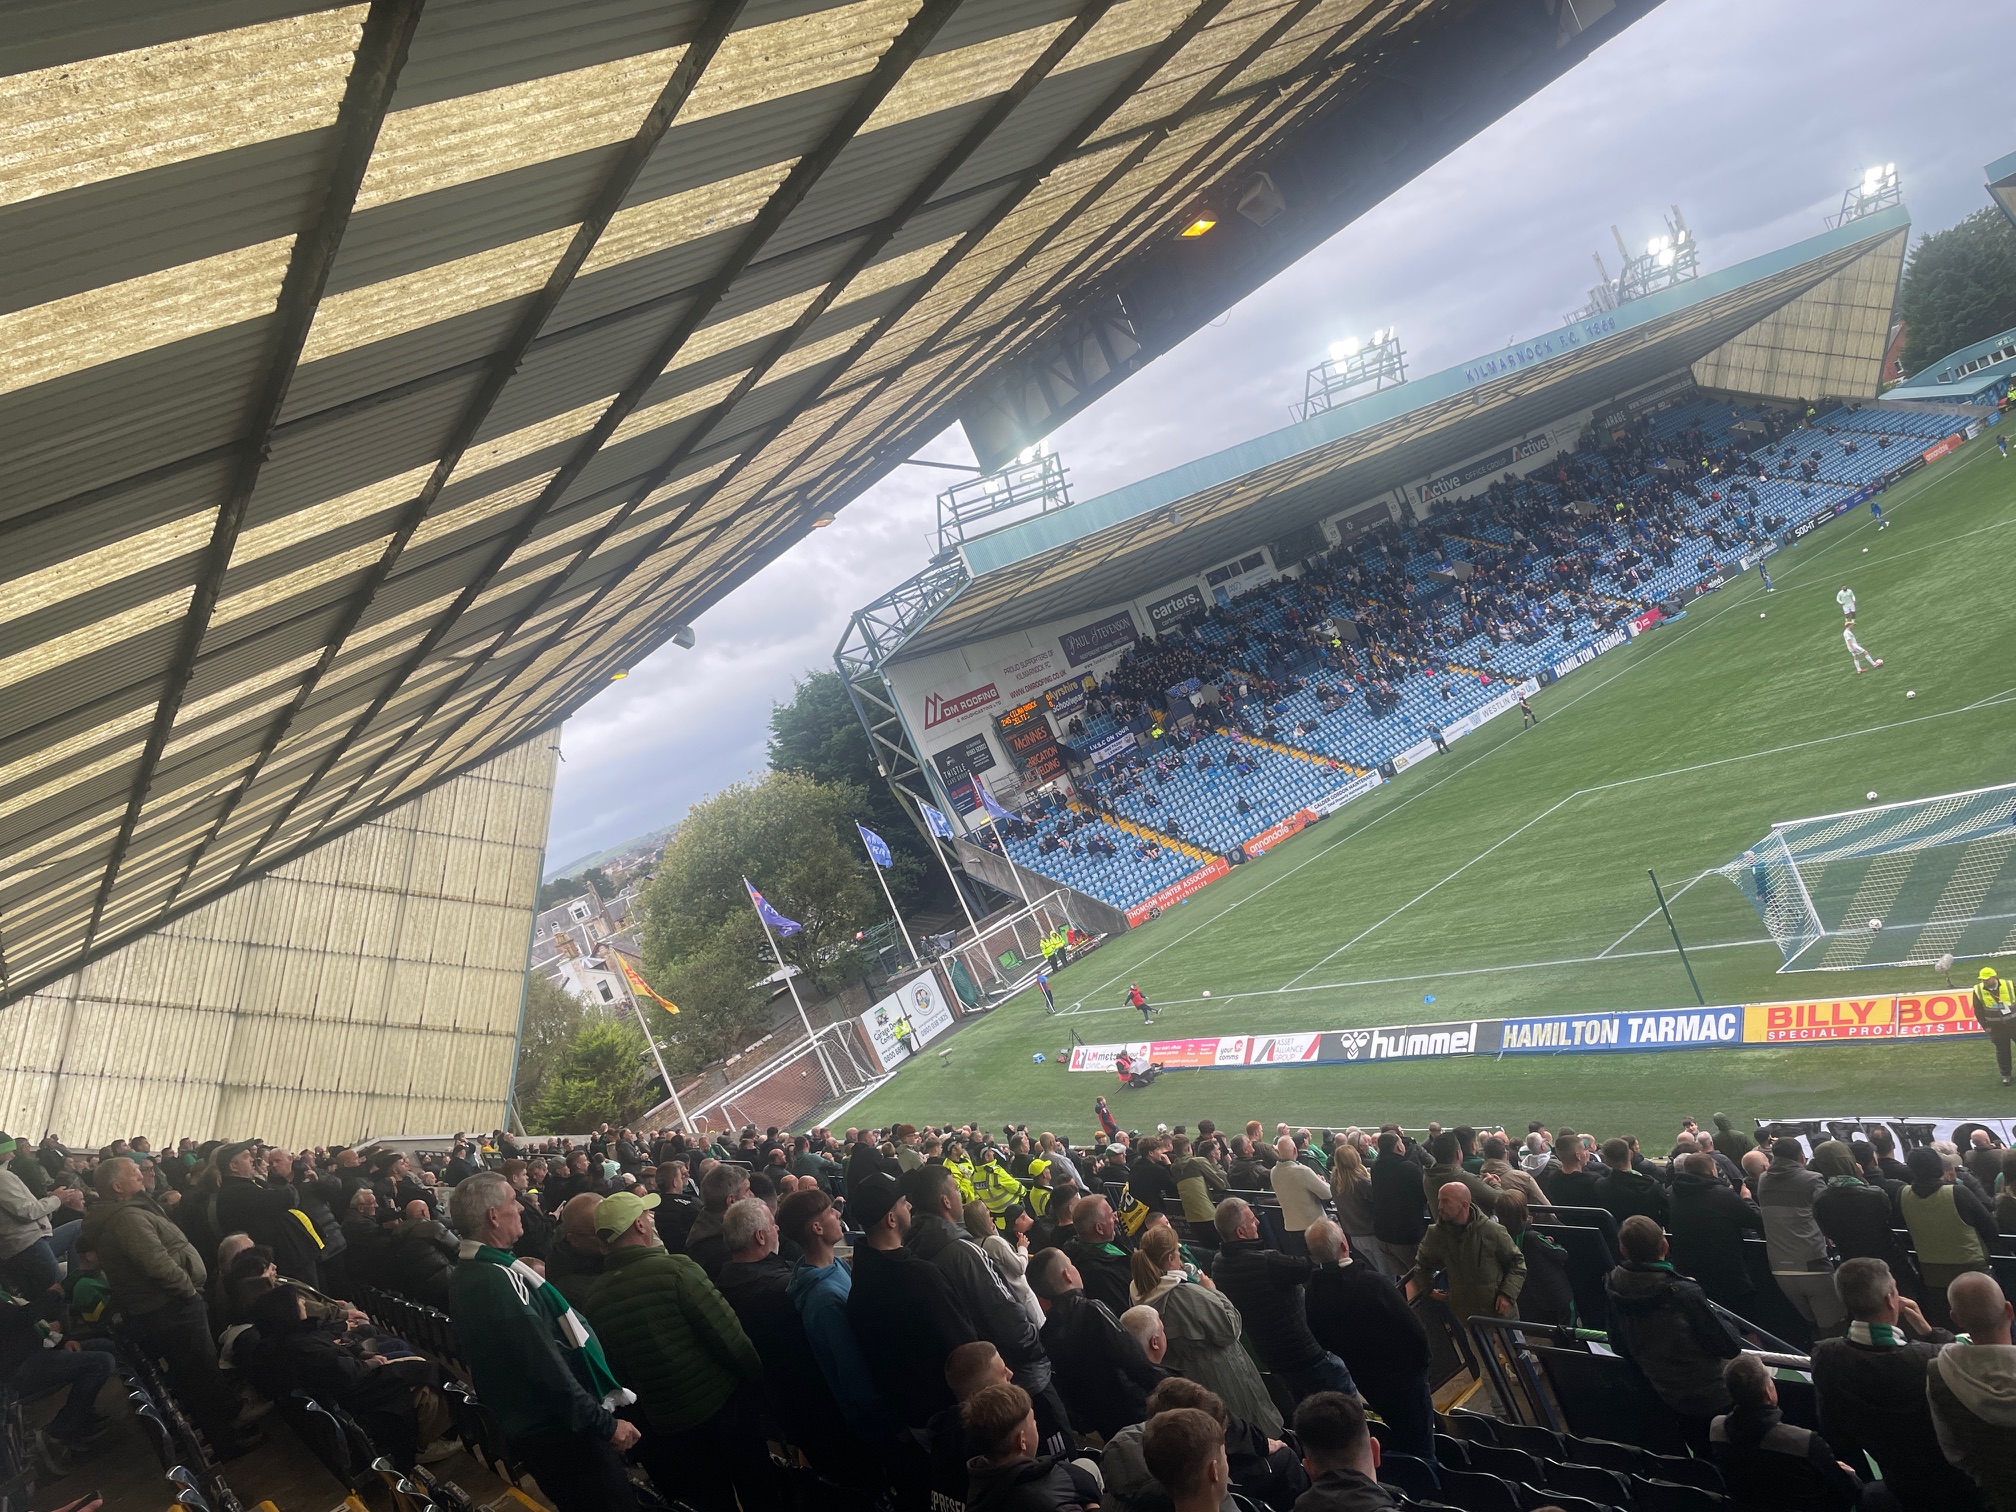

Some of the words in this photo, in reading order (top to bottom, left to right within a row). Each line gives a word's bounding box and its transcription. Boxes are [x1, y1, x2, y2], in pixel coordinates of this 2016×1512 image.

[1464, 340, 1553, 383] KILMARNOCK
[1558, 330, 1580, 349] F.C.
[1586, 316, 1616, 338] 1869
[1512, 438, 1548, 463] Active
[1421, 475, 1461, 503] Active
[1464, 467, 1486, 481] OFFICE
[1486, 457, 1507, 471] GROUP
[1152, 593, 1200, 620] carters.
[1066, 634, 1091, 656] PAUL
[1091, 617, 1131, 646] STEVENSON
[1003, 663, 1021, 676] PROUD
[1020, 653, 1049, 669] SUPPORTERS
[1047, 649, 1054, 659] OF
[1553, 646, 1596, 679] HAMILTON
[1593, 628, 1627, 656] TARMAC
[1008, 668, 1068, 699] WWW.DMROOFING.CO.UK
[1015, 665, 1045, 681] KILMARNOCK
[1044, 661, 1052, 670] FC
[943, 704, 960, 718] DM
[959, 688, 998, 711] ROOFING
[1048, 681, 1079, 701] Ayrshire
[992, 700, 1002, 708] LTD
[1481, 696, 1511, 718] WESTLIN
[1014, 725, 1048, 752] McINNES
[1106, 734, 1116, 743] ON
[1115, 725, 1130, 738] TOUR
[943, 763, 967, 780] THISTLE
[1313, 796, 1331, 810] CALDER
[1330, 786, 1349, 801] GORDON
[1348, 771, 1378, 791] MAINTENANCE
[1249, 824, 1290, 853] annandale
[1127, 899, 1158, 920] THOMSON
[1158, 884, 1182, 903] HUNTER
[1182, 865, 1216, 891] ASSOCIATES
[1175, 880, 1208, 901] architects
[1767, 1000, 1878, 1030] BILLY
[873, 1023, 891, 1042] Garage
[920, 1025, 932, 1037] 0800
[1277, 1038, 1295, 1046] ASSET
[1369, 1022, 1479, 1059] hummel
[1502, 1018, 1620, 1049] HAMILTON
[1627, 1012, 1737, 1044] TARMAC
[1767, 1026, 1839, 1041] SPECIAL
[1848, 1023, 1945, 1037] PROJECTS
[883, 1051, 896, 1063] 0800
[1220, 1047, 1234, 1055] your
[1274, 1053, 1296, 1062] GROUP
[1276, 1045, 1304, 1054] ALLIANCE
